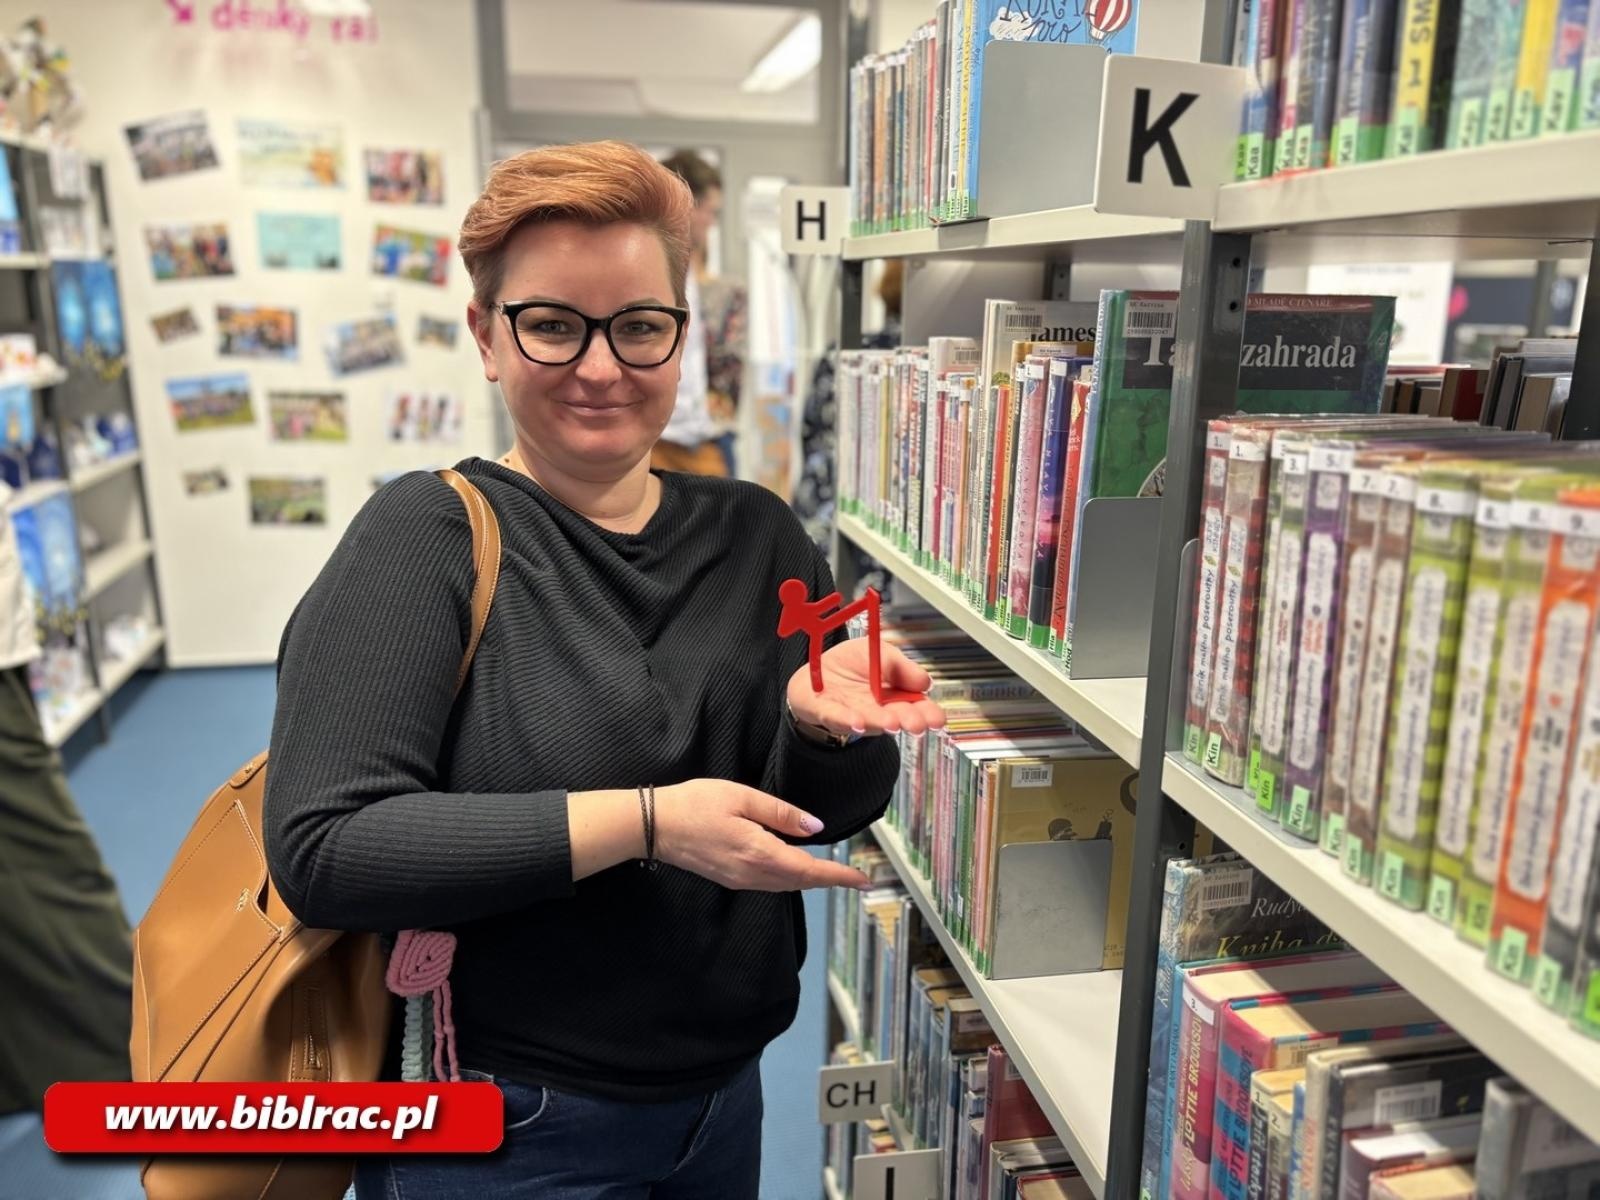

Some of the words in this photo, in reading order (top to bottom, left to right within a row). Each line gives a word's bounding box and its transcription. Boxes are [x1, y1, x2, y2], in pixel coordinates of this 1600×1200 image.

[1127, 88, 1201, 188] K
[1248, 147, 1260, 176] Kaa
[797, 200, 825, 241] H
[1241, 335, 1356, 368] zahrada
[1201, 569, 1214, 630] poseroutky
[1224, 580, 1238, 643] poseroutky
[1064, 648, 1072, 670] Hod
[1189, 733, 1198, 753] Kin
[1207, 743, 1219, 764] Kin
[1262, 780, 1270, 800] Kin
[1292, 803, 1305, 826] Kin
[1252, 896, 1307, 918] Rudy
[826, 1080, 877, 1108] CH
